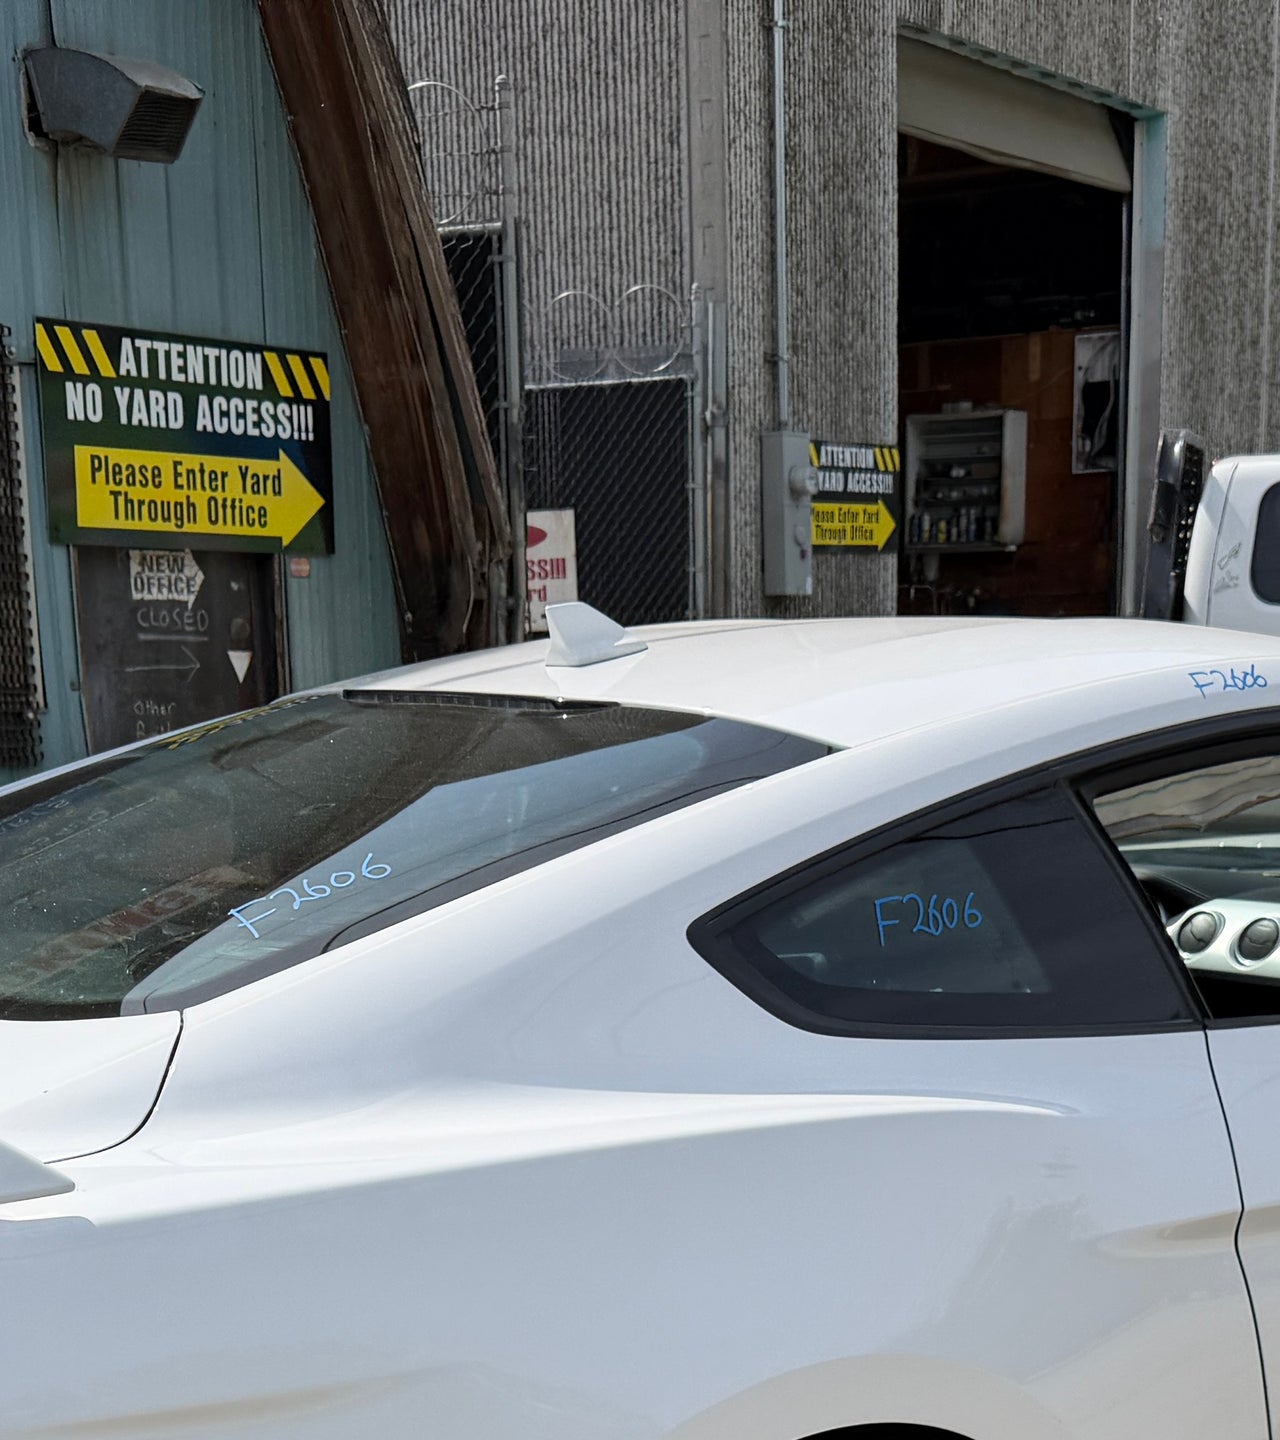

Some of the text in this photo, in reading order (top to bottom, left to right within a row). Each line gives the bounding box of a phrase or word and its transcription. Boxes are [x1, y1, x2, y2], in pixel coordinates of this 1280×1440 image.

[120, 337, 263, 391] ATTENTION
[65, 381, 315, 442] NO YARD ACCESS!!!
[819, 445, 874, 469] ATTENTION
[90, 454, 282, 497] Please Enter Yard
[109, 491, 268, 529] Through Office
[837, 507, 859, 523] Enter
[862, 508, 879, 524] Yard
[815, 524, 873, 544] Through Office
[139, 553, 185, 574] NEW
[133, 571, 196, 596] OFFICE
[136, 607, 209, 632] CLOSED
[1188, 664, 1267, 699] F2606
[227, 853, 391, 939] F2606
[875, 892, 983, 947] F2606
